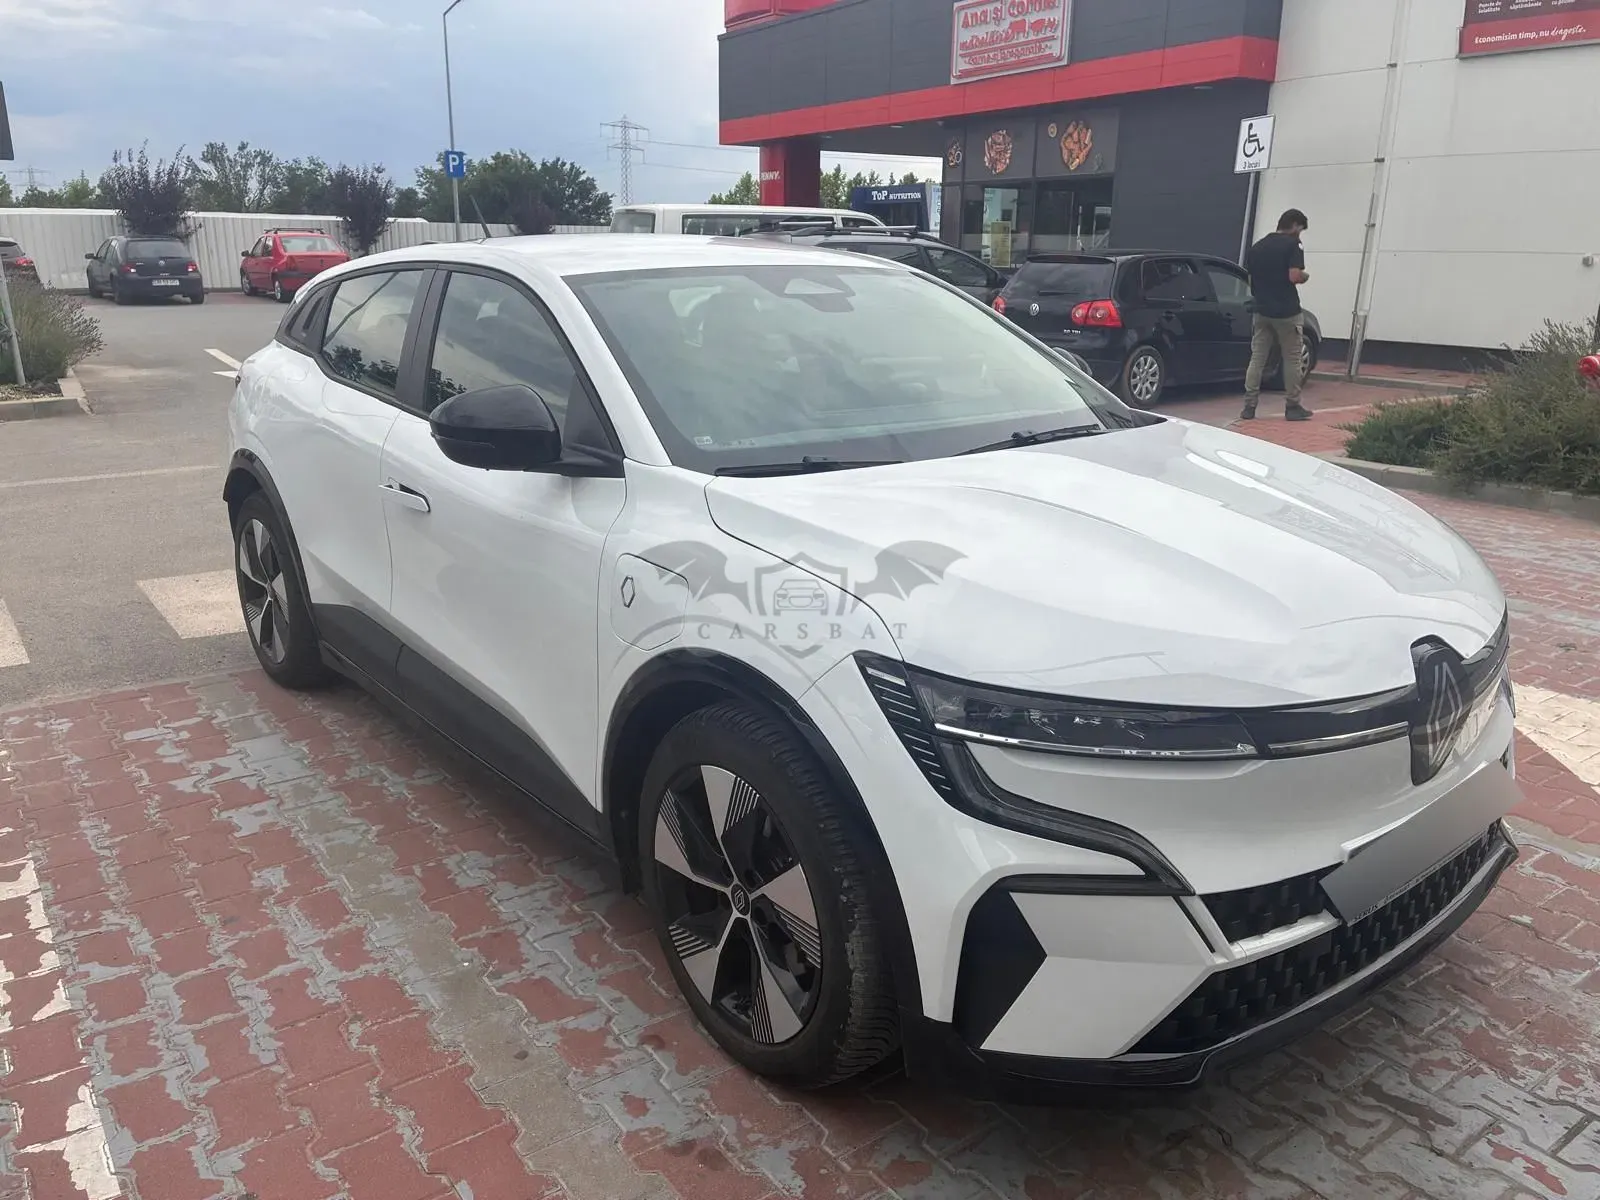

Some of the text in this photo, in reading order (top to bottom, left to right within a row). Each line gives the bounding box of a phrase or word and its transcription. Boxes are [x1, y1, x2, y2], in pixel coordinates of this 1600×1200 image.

[961, 8, 990, 28] Ana
[1475, 32, 1518, 44] Economisim
[1519, 31, 1538, 40] timp,
[448, 153, 460, 173] P
[1242, 160, 1261, 170] 3 locuri
[888, 191, 922, 201] NUTRITION
